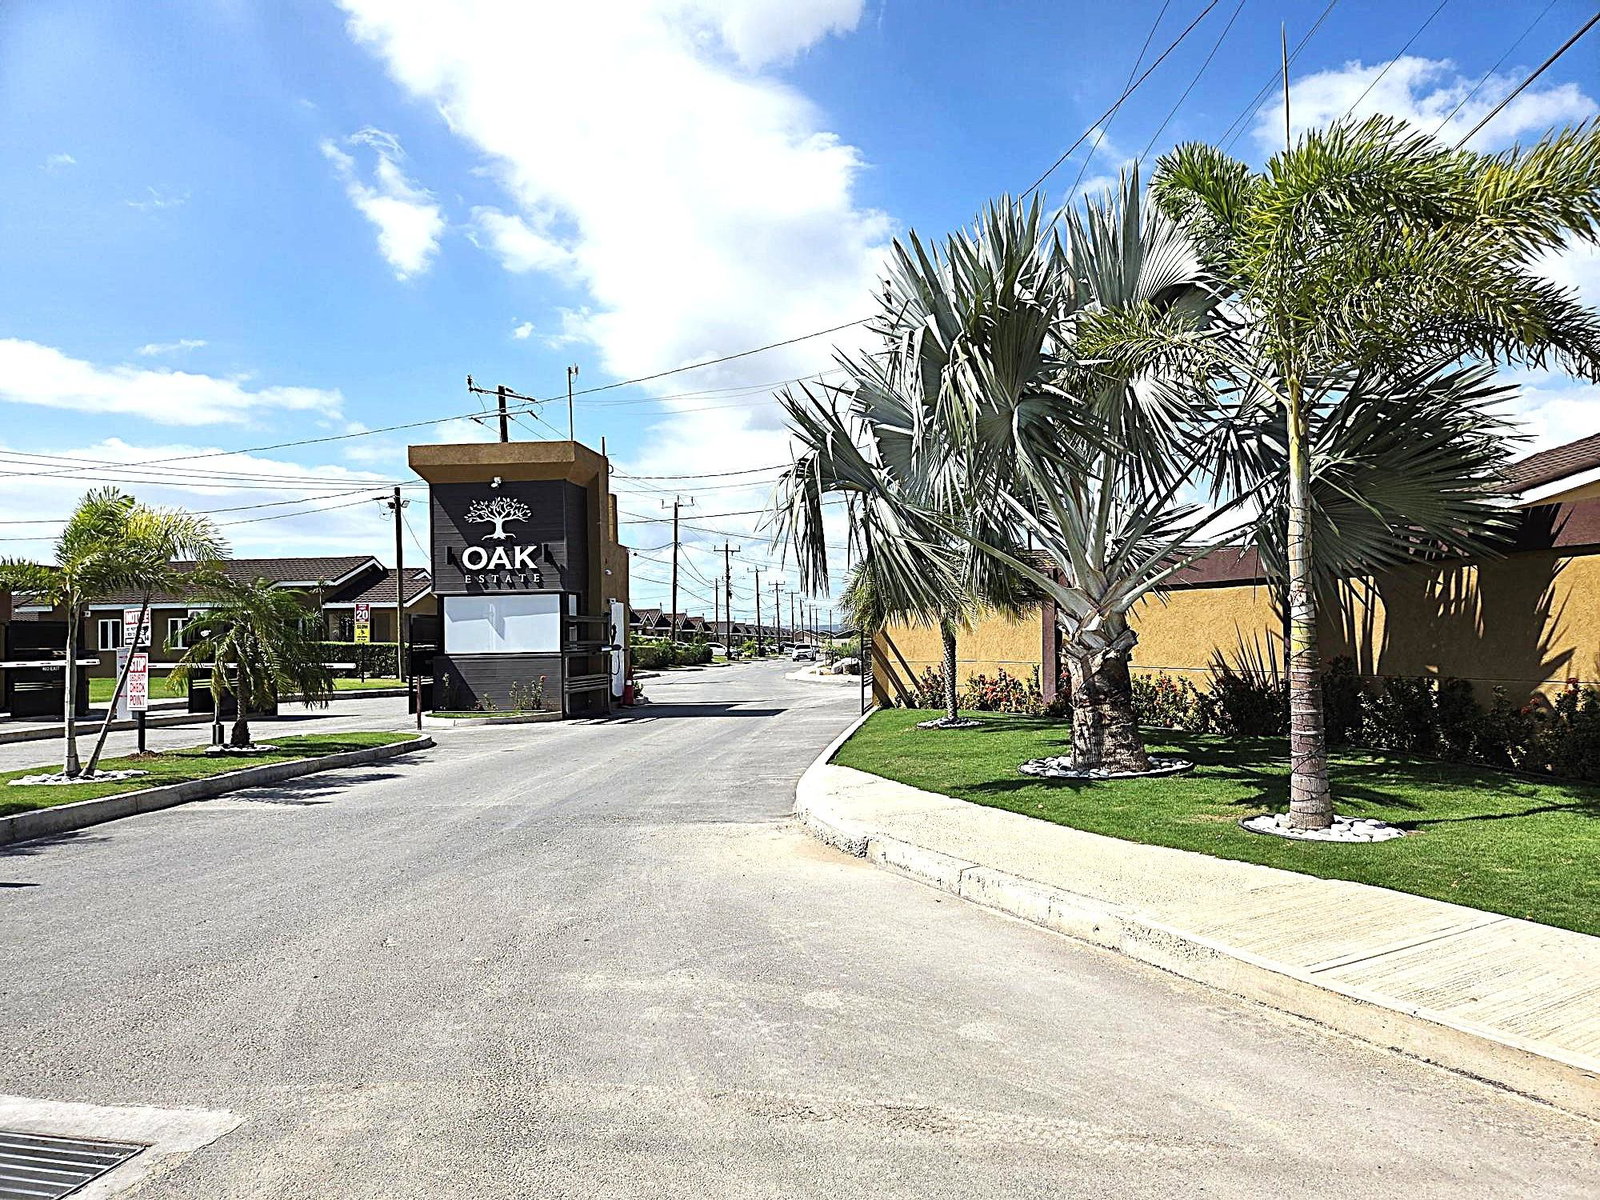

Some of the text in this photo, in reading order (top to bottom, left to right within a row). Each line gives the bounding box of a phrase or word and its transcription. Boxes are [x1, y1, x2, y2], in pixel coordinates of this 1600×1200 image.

[462, 546, 538, 570] OAK
[465, 573, 540, 583] ESTATE
[356, 610, 368, 619] 20
[130, 658, 146, 671] STOP
[130, 683, 145, 692] CHECK
[130, 695, 145, 705] POINT
